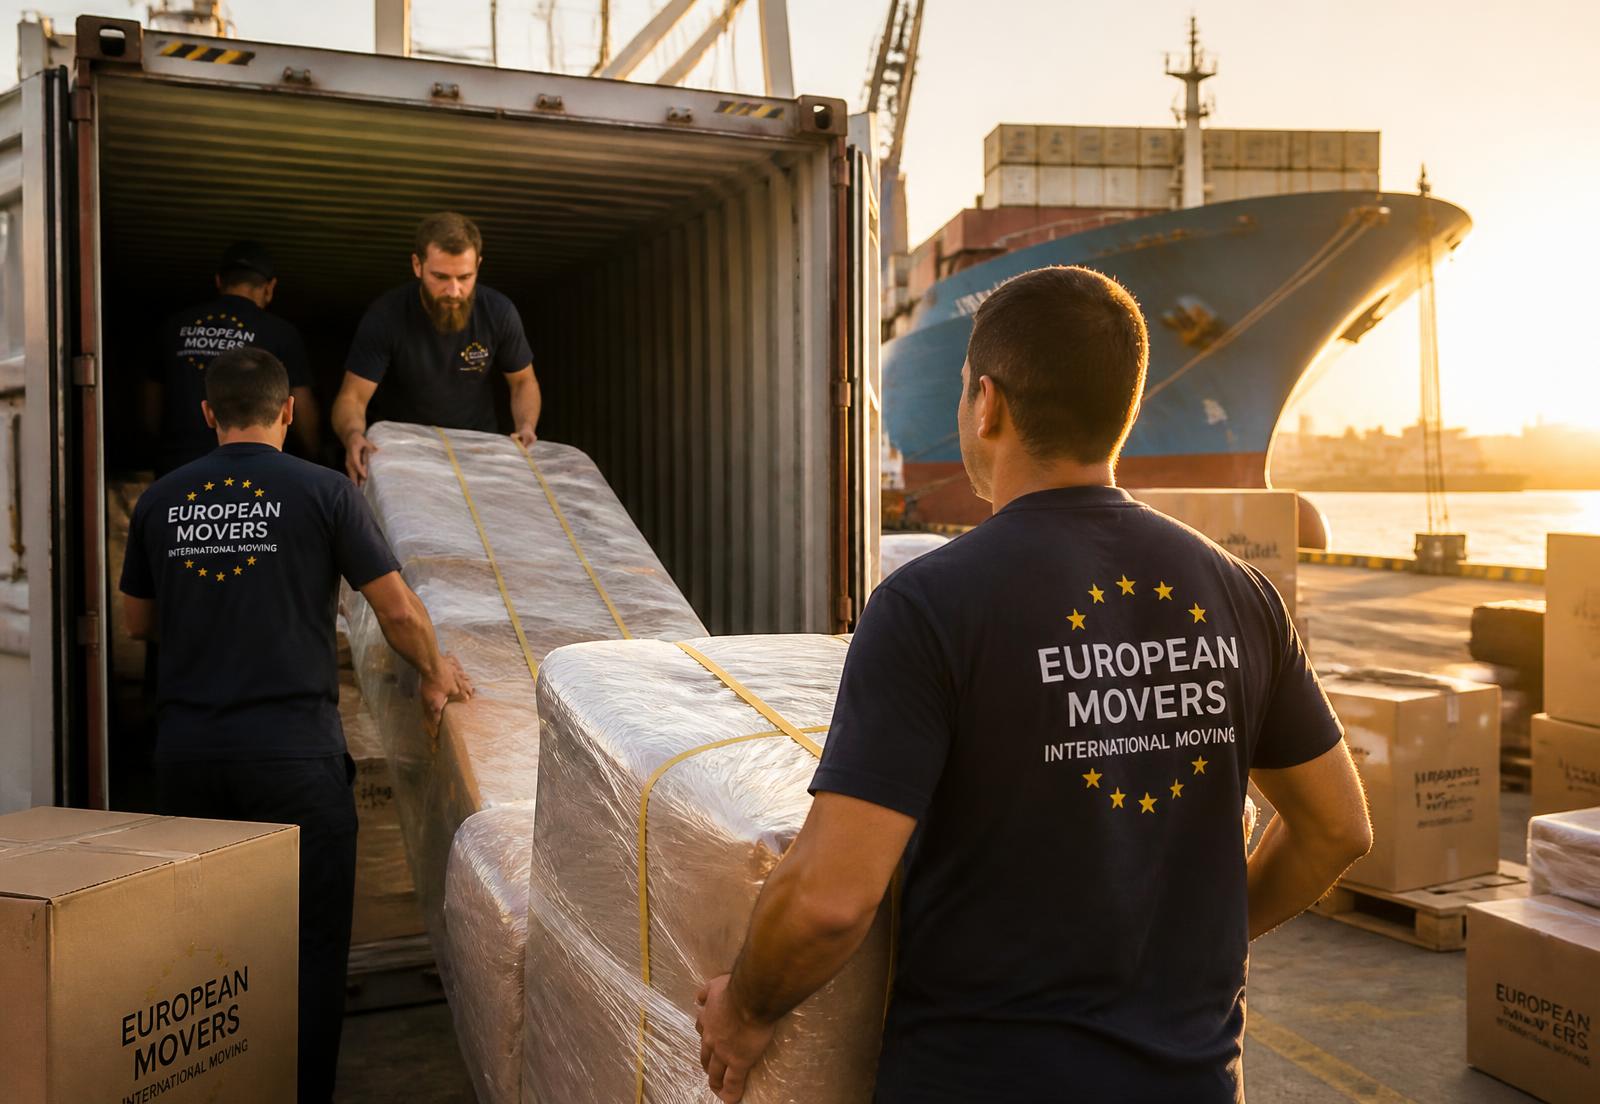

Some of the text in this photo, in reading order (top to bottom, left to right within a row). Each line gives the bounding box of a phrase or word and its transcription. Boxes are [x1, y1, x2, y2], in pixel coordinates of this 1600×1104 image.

[180, 326, 255, 342] EUROPEAN
[185, 337, 246, 350] MOVERS
[168, 501, 281, 523] EUROPEAN
[177, 521, 268, 542] MOVERS
[1038, 635, 1239, 683] EUROPEAN
[1068, 680, 1226, 727] MOVERS
[1044, 726, 1235, 762] INTERNATIONAL MOVING
[122, 966, 248, 1047] EUROPEAN
[1496, 983, 1590, 1031] EUROPEAN
[134, 1004, 240, 1081] MOVERS
[209, 1038, 248, 1070] MOVING
